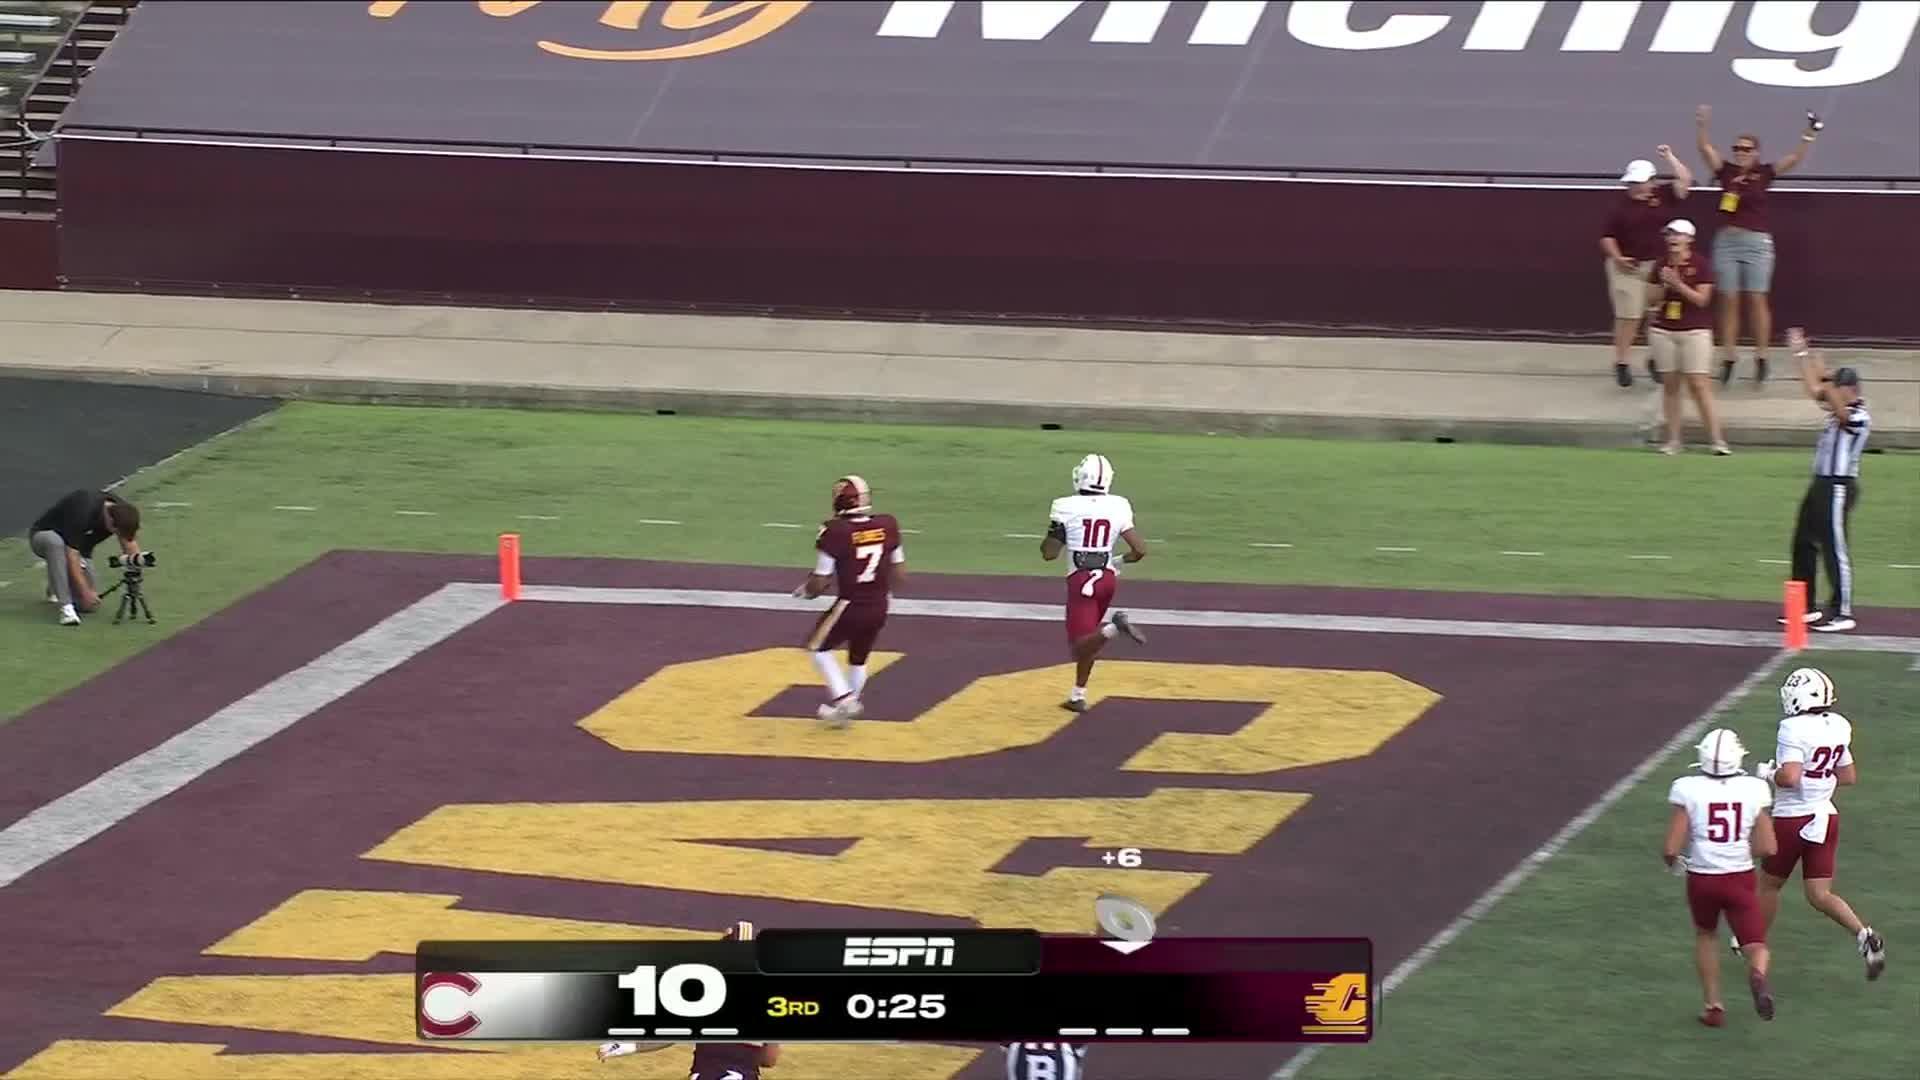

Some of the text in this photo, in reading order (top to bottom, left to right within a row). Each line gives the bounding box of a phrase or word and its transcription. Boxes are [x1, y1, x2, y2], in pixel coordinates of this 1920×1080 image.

[1082, 518, 1111, 548] 10
[855, 544, 884, 583] 7
[1707, 802, 1742, 843] 51
